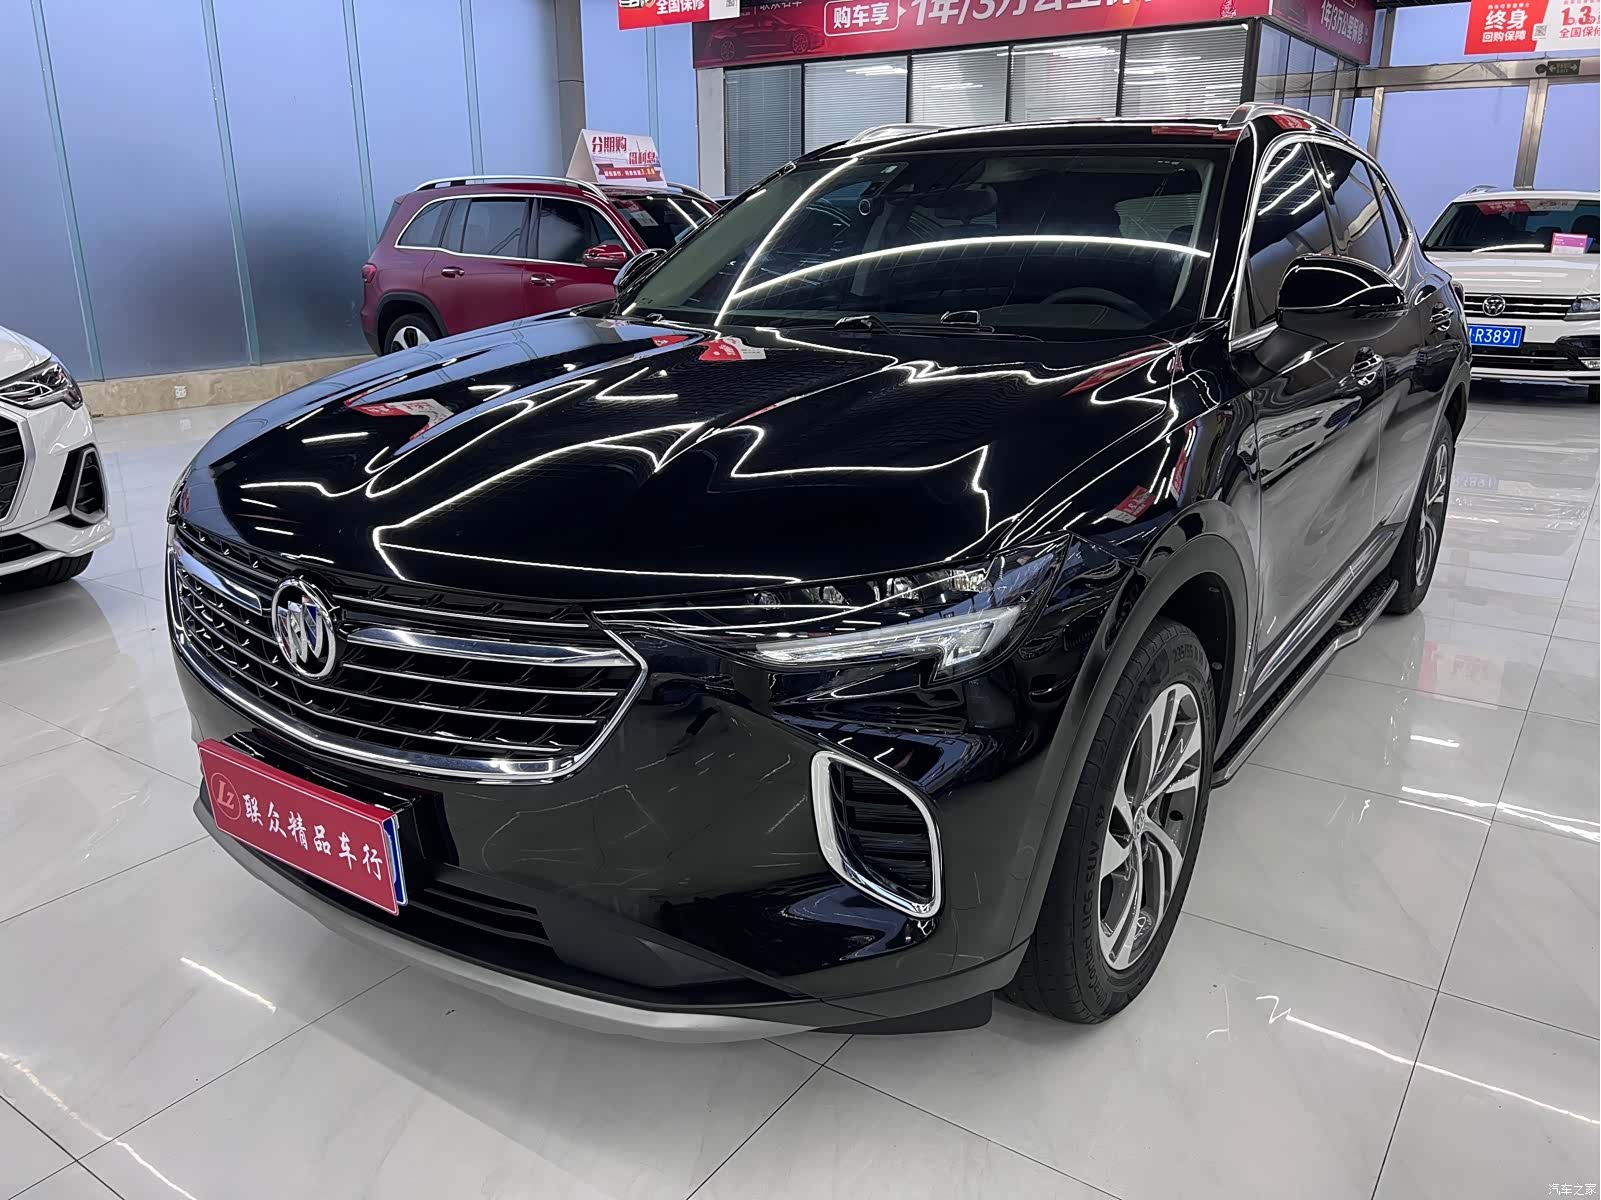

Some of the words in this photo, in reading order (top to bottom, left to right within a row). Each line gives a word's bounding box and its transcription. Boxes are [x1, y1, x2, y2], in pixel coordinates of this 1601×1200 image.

[833, 2, 890, 29] 购车享
[1484, 9, 1528, 30] 终身
[1482, 30, 1526, 43] 回购保障
[592, 136, 627, 153] 分期购
[242, 794, 382, 880] 联众精品车行
[1085, 841, 1099, 883] SUV
[1082, 889, 1094, 929] UC6
